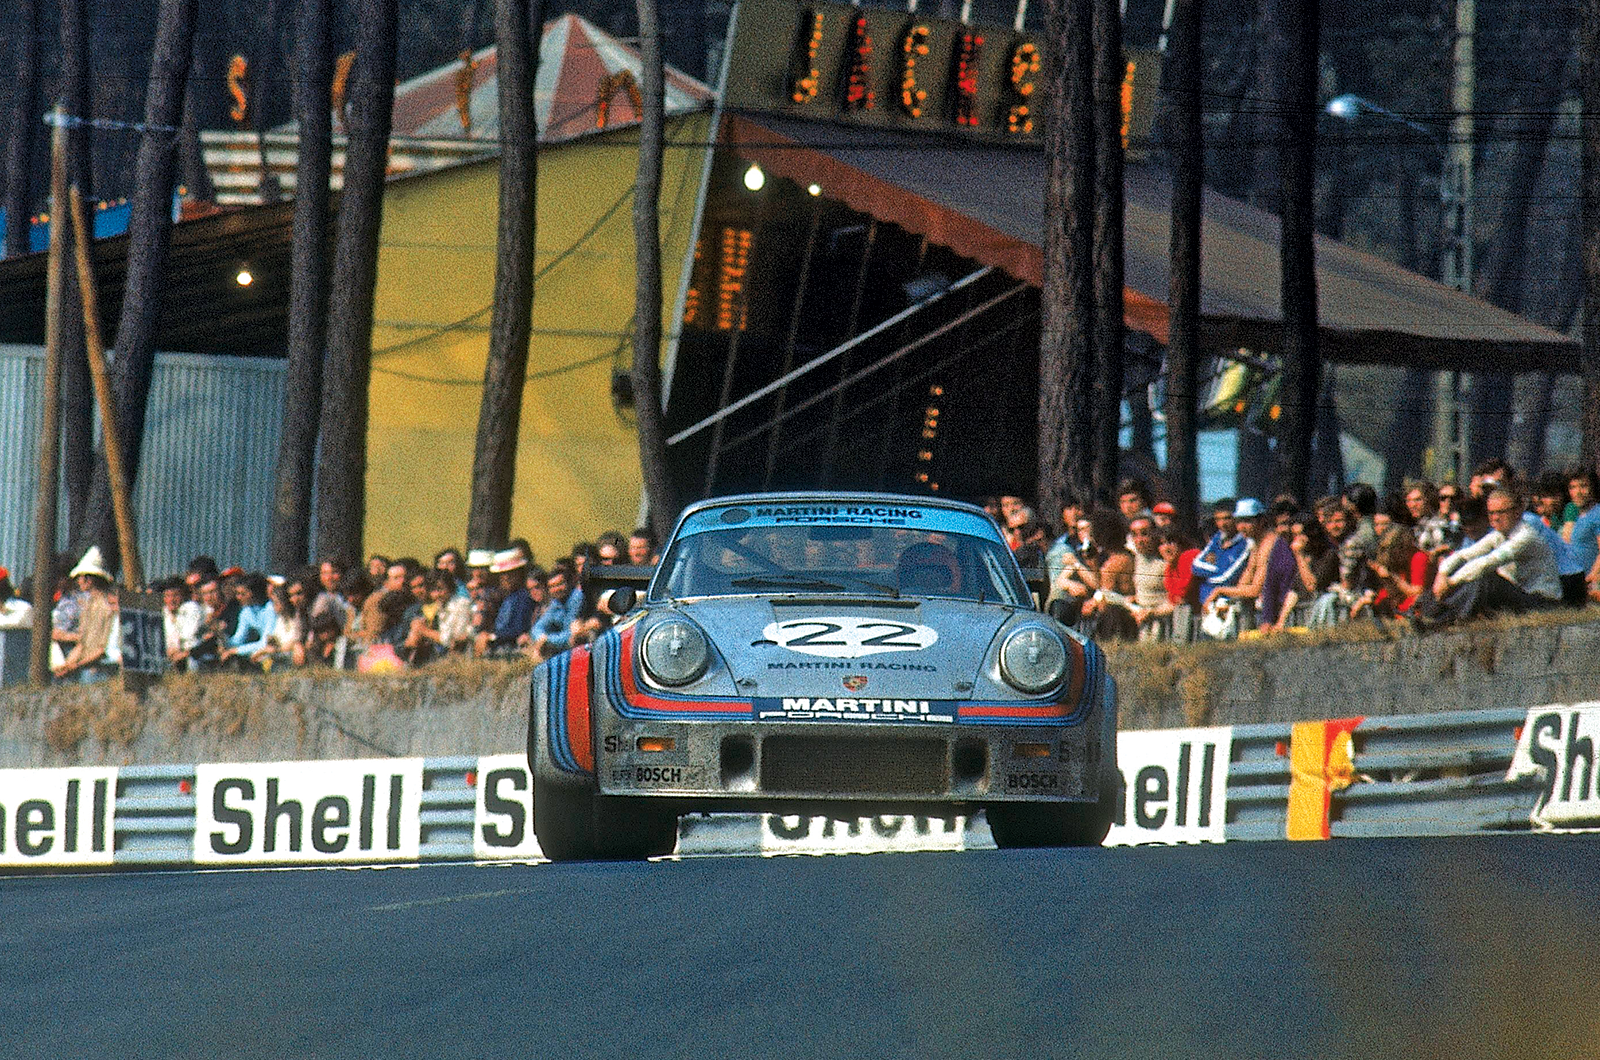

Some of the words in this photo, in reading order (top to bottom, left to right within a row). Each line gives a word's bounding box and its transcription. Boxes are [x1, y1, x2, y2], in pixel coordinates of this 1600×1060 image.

[756, 507, 841, 517] MARTINI
[849, 507, 923, 519] RACING
[781, 622, 922, 648] 22
[767, 662, 851, 671] MARTINI
[860, 663, 937, 673] RACING
[782, 698, 931, 714] MARTINI
[759, 711, 954, 723] PORSCHE
[636, 767, 682, 783] BOSCH
[1008, 773, 1058, 789] BOSCH
[0, 777, 109, 857] ell
[209, 774, 404, 855] Shell
